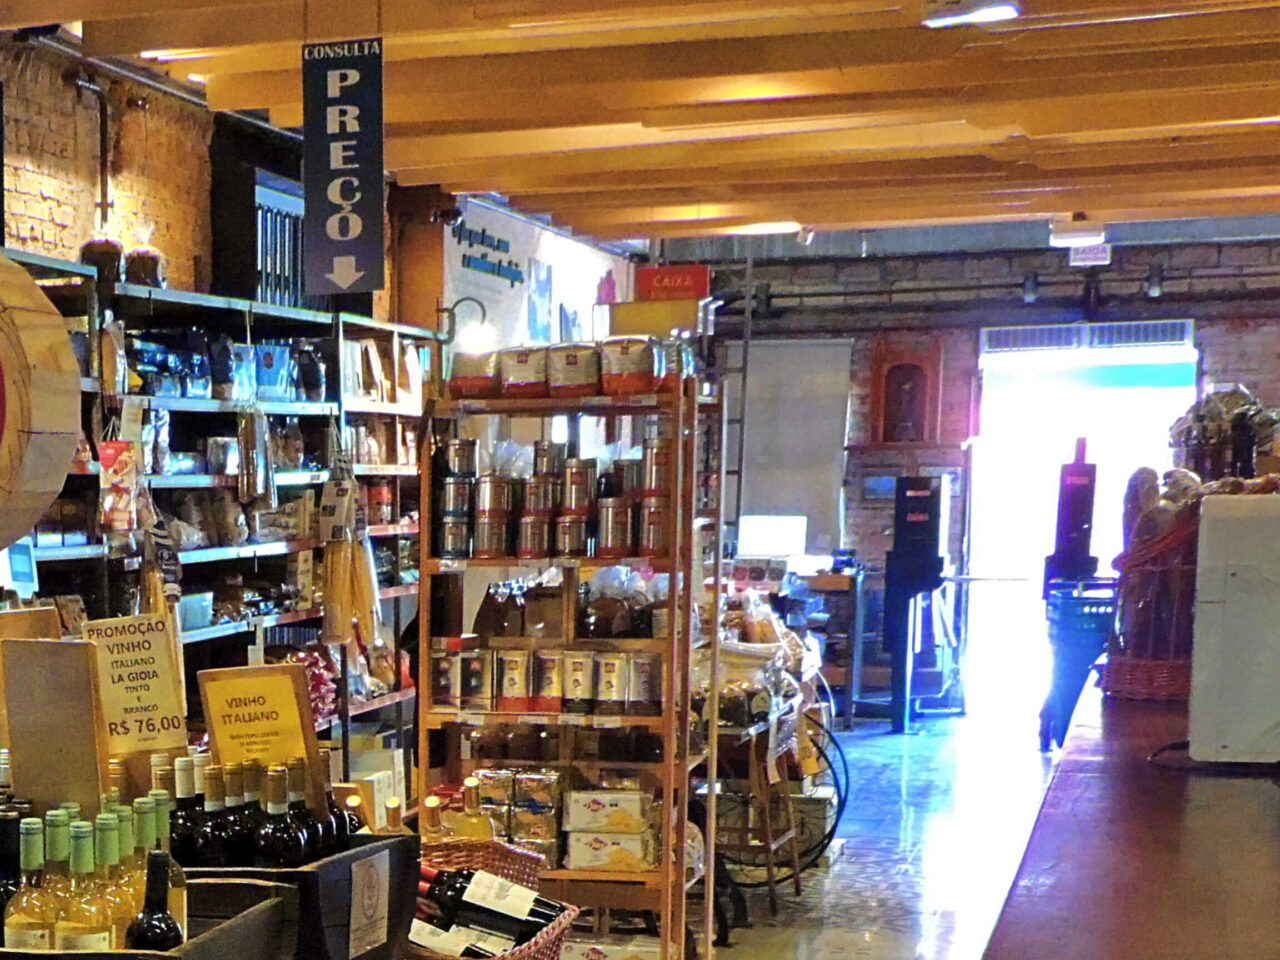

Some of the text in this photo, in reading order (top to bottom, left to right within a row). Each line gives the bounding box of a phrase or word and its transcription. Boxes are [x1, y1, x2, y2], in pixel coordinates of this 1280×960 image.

[304, 41, 380, 60] CONSULTA
[325, 69, 363, 241] PREÇO
[88, 620, 166, 640] PROMOÇÃO
[107, 640, 151, 655] VINHO
[111, 656, 155, 669] ITALIANO
[111, 670, 159, 684] LA GIOIA
[124, 683, 150, 694] TINTO
[225, 695, 266, 708] VINHO
[123, 703, 158, 715] BRANCO
[221, 711, 279, 725] ITALIANO
[109, 715, 181, 737] R$ 76,00
